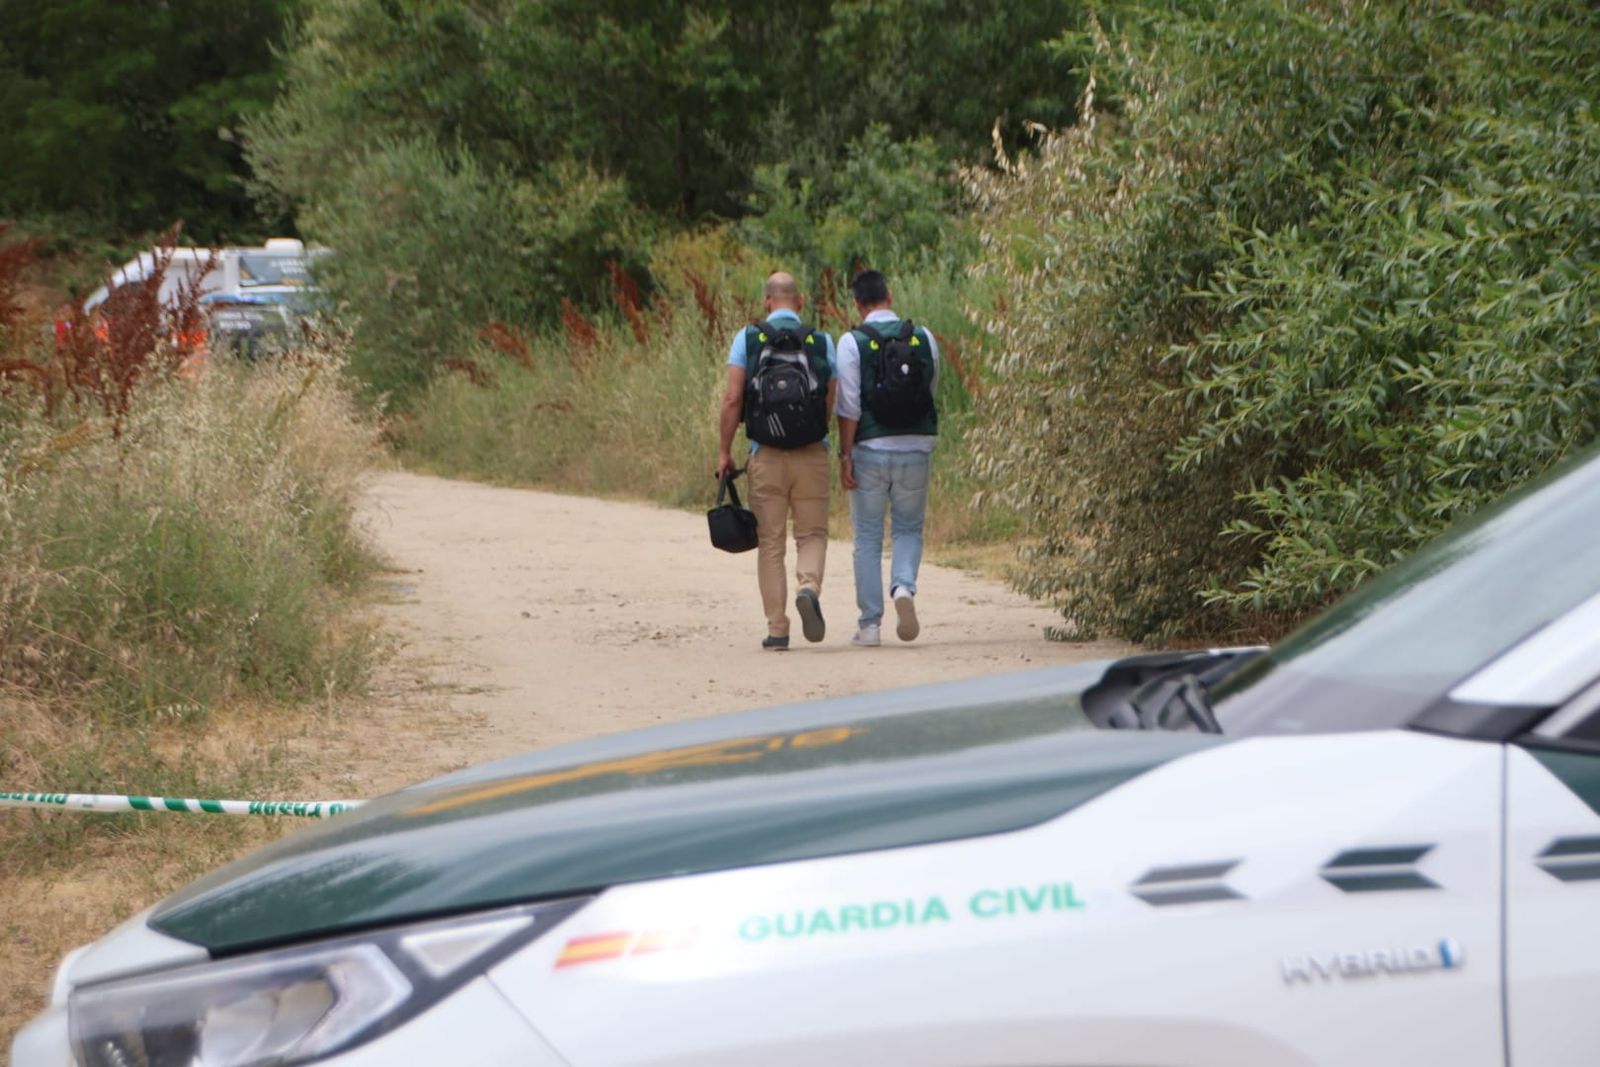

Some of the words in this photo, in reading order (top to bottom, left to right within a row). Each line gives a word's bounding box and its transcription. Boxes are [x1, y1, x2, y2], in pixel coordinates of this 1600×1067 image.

[738, 895, 951, 942] GUARDIA
[968, 882, 1086, 918] CIVIL
[1281, 948, 1435, 984] HYBRID
